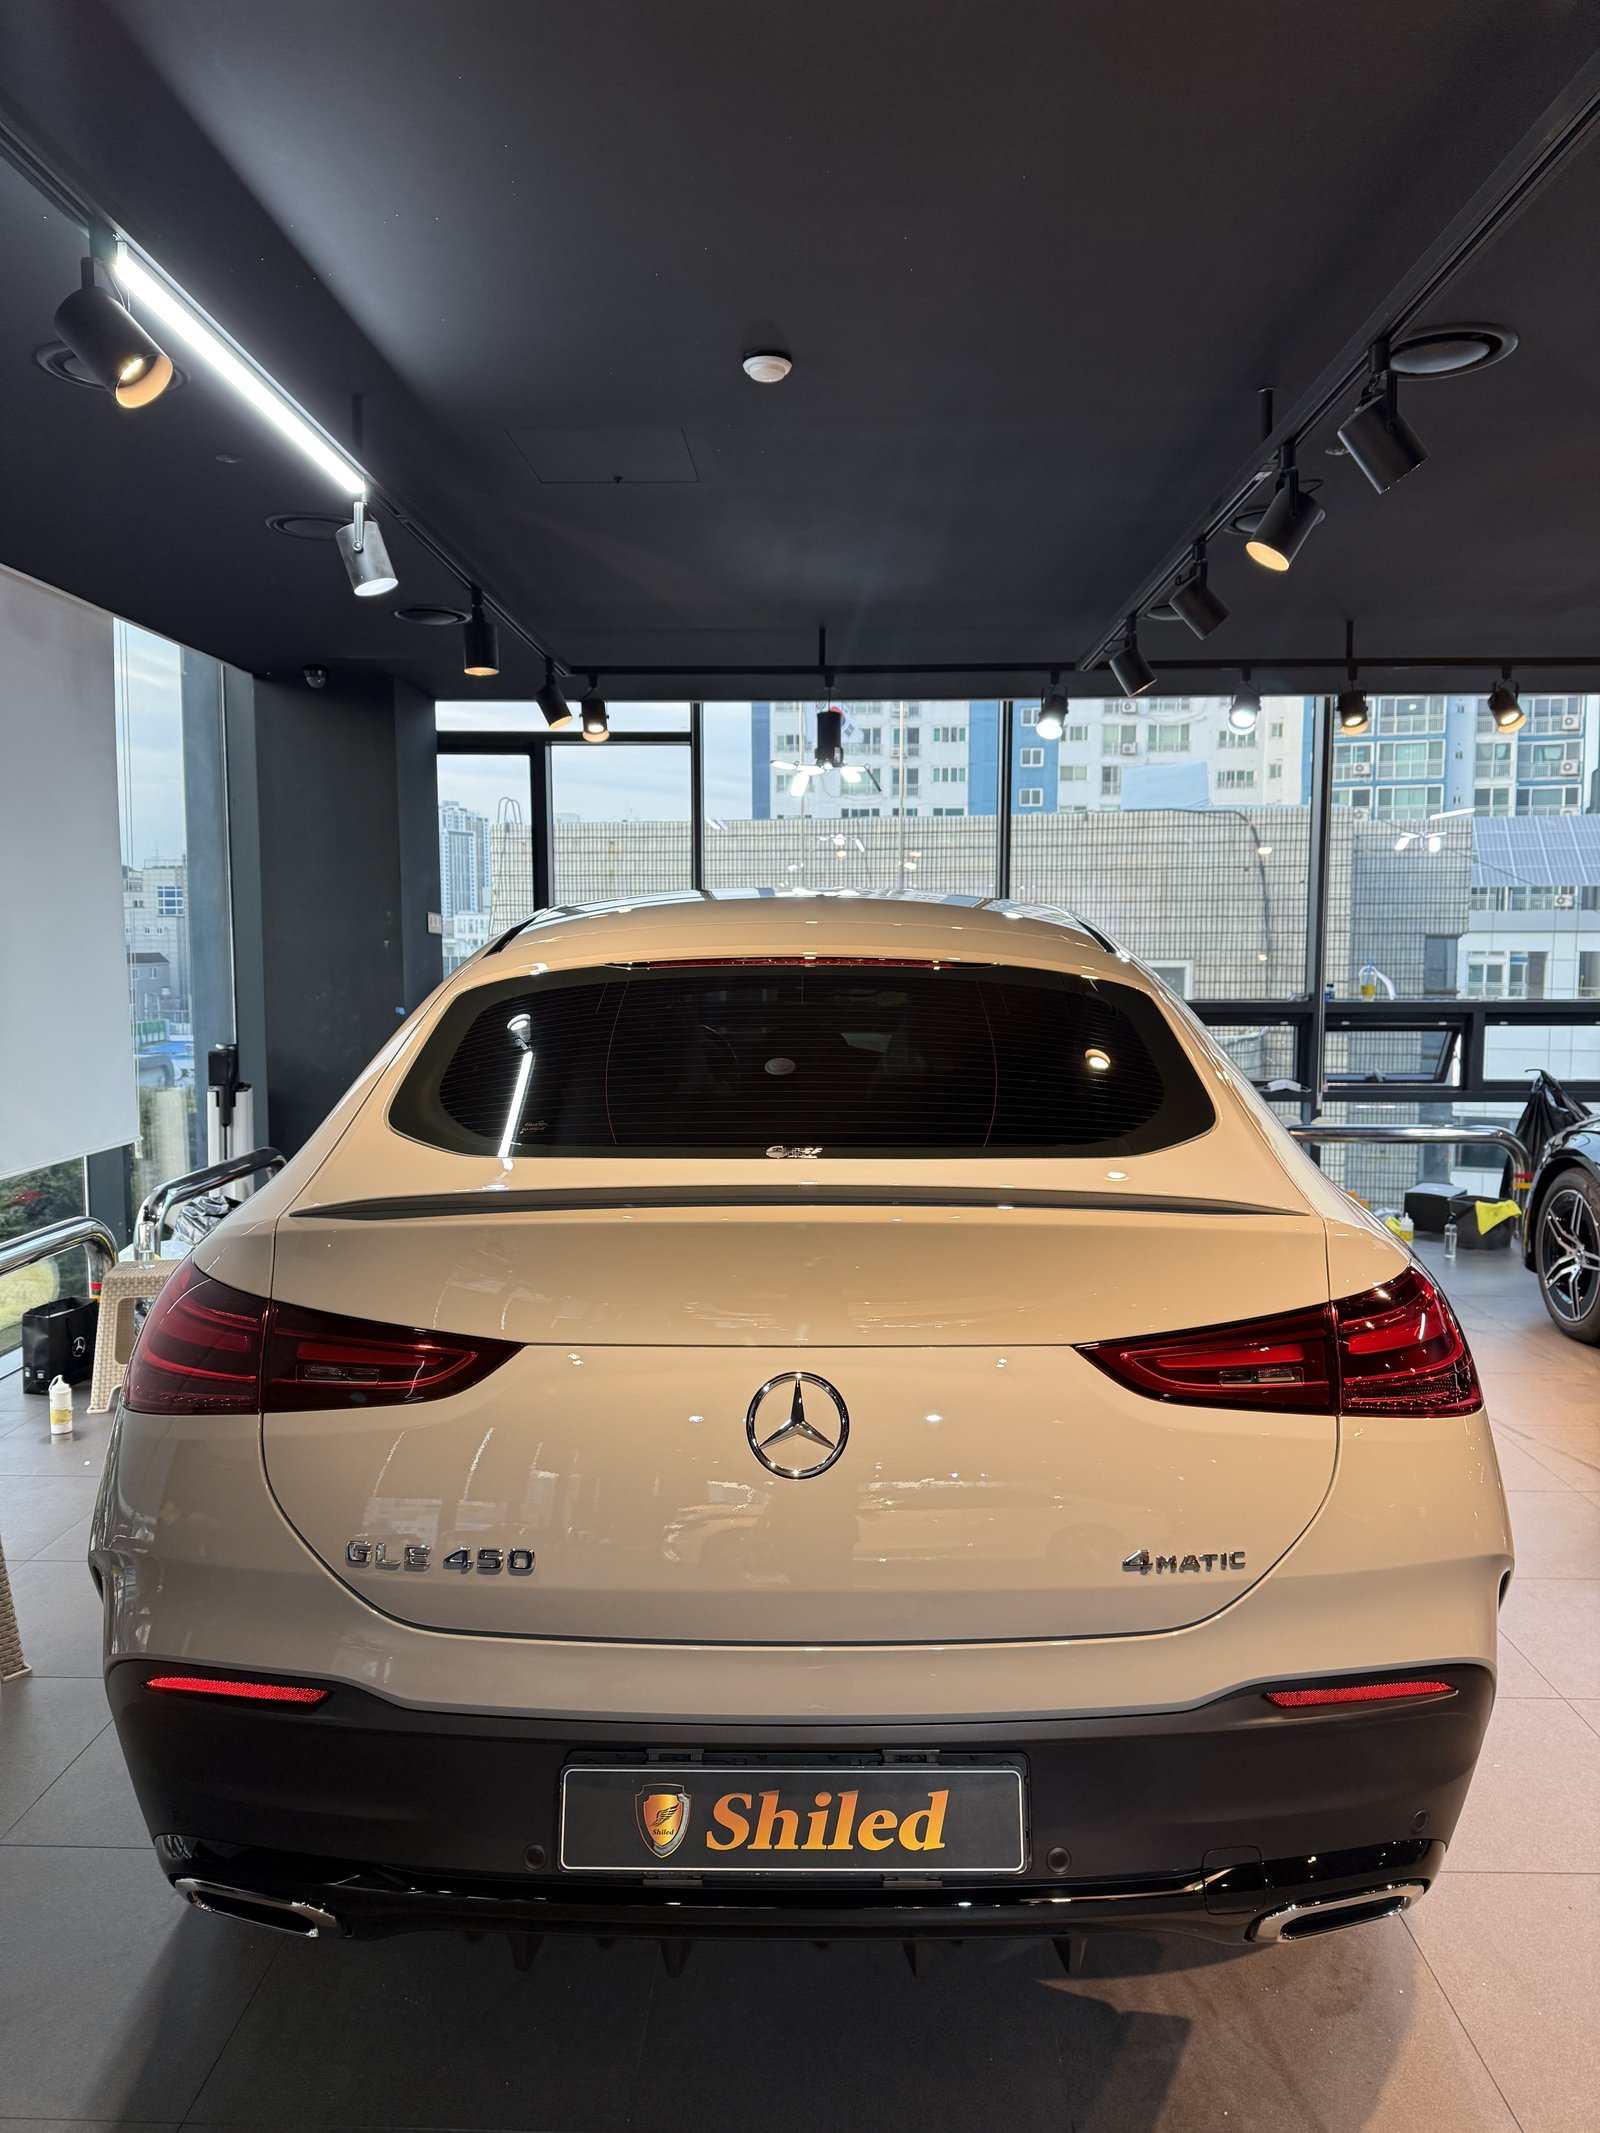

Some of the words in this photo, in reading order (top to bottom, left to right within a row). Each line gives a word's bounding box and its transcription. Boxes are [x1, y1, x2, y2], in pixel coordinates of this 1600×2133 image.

[346, 1540, 431, 1571] GLE
[442, 1546, 535, 1574] 450
[1122, 1549, 1246, 1574] 4MATIC
[706, 1789, 949, 1852] Shiled
